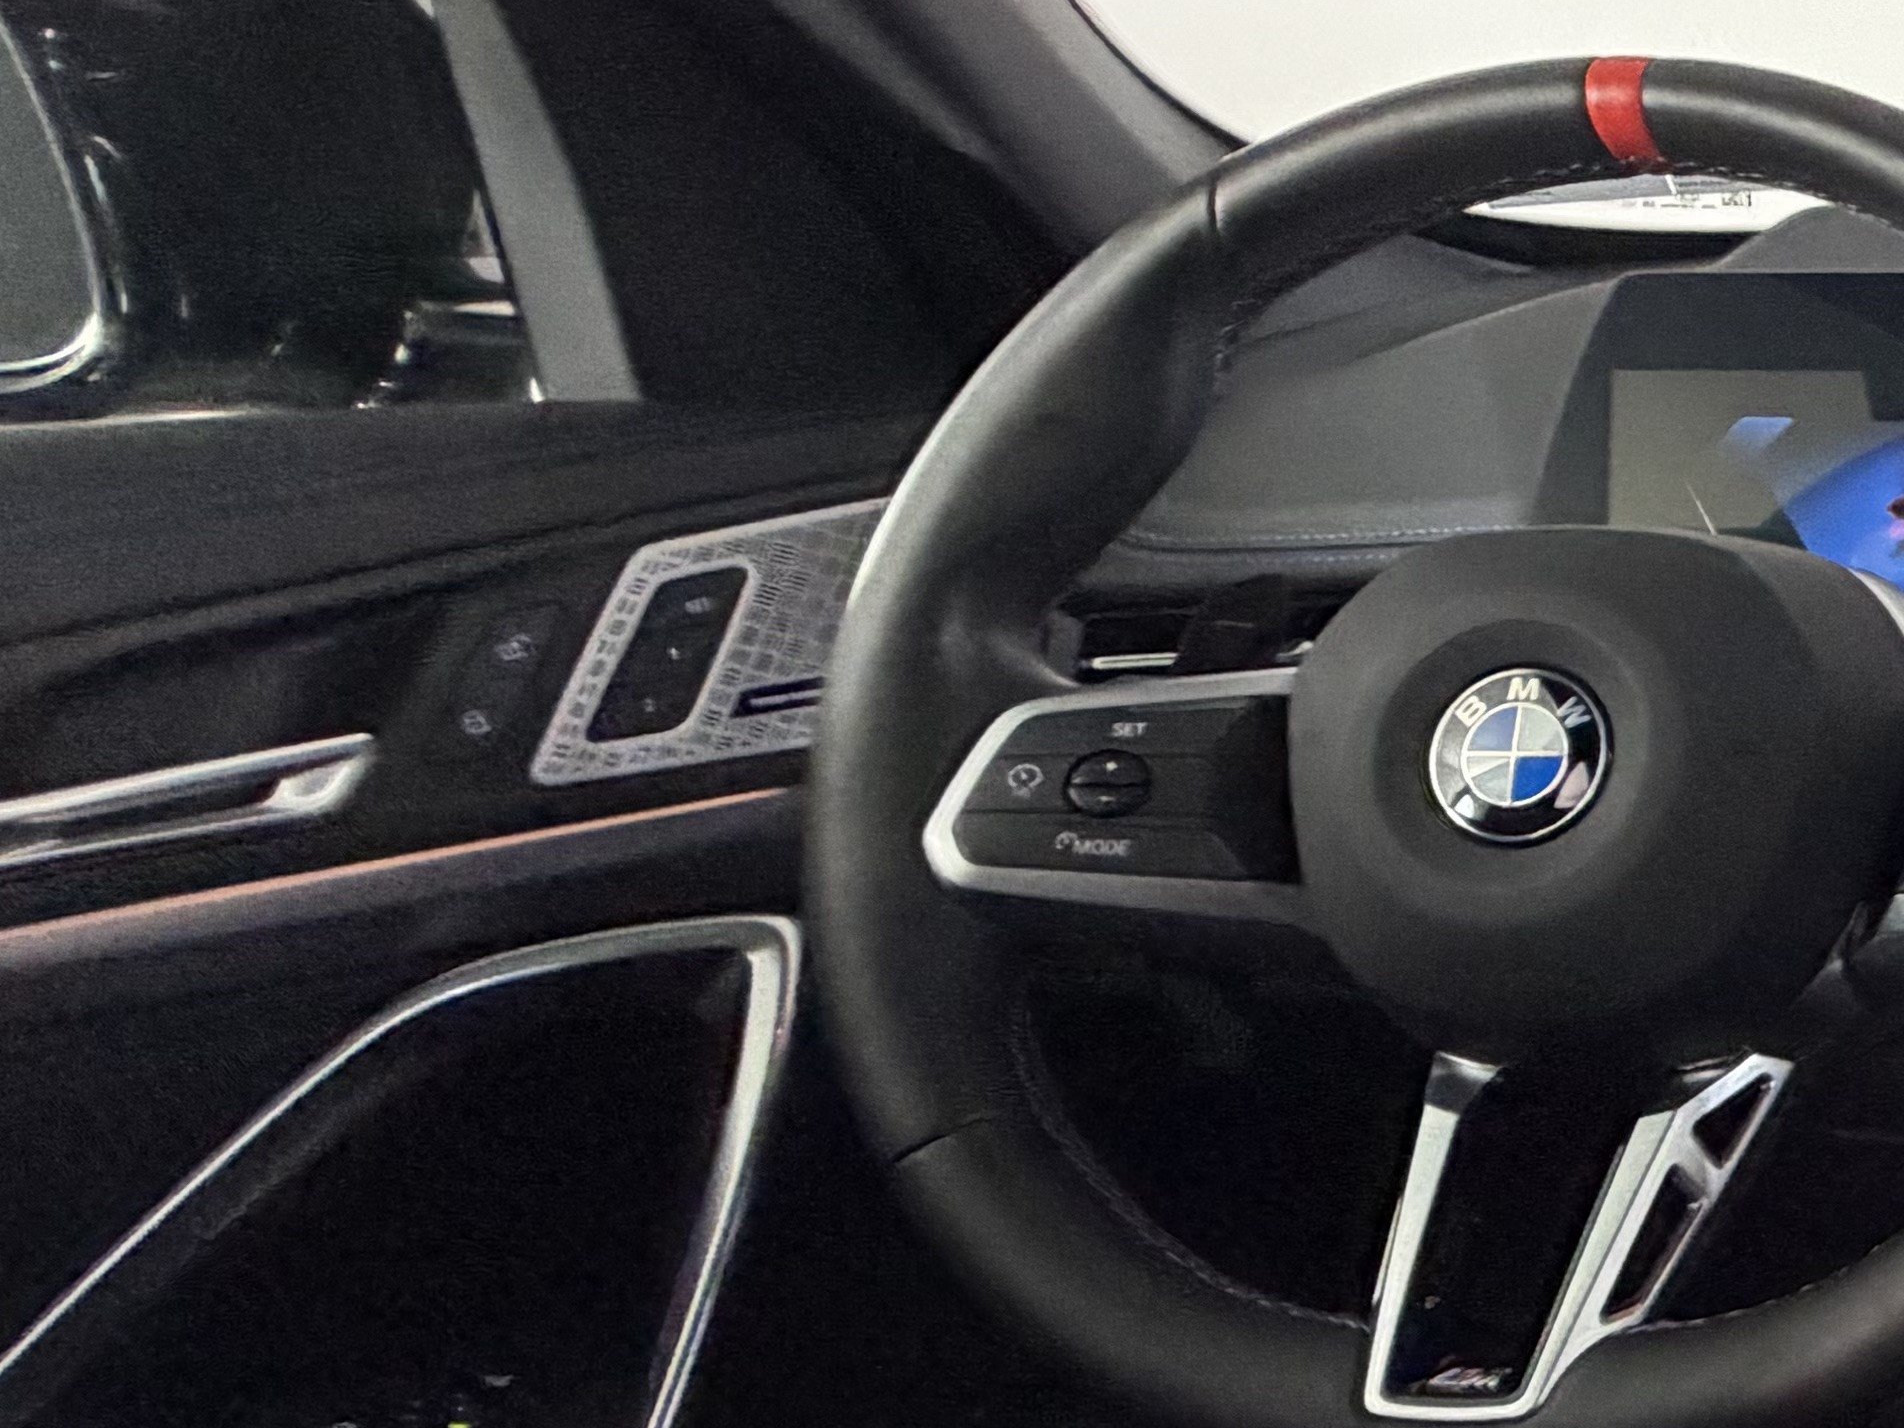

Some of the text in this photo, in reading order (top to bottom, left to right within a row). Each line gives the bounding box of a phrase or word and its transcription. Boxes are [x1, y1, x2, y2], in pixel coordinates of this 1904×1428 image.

[1454, 676, 1592, 729] BMW
[1110, 722, 1149, 738] SET
[1072, 838, 1132, 857] MODE
